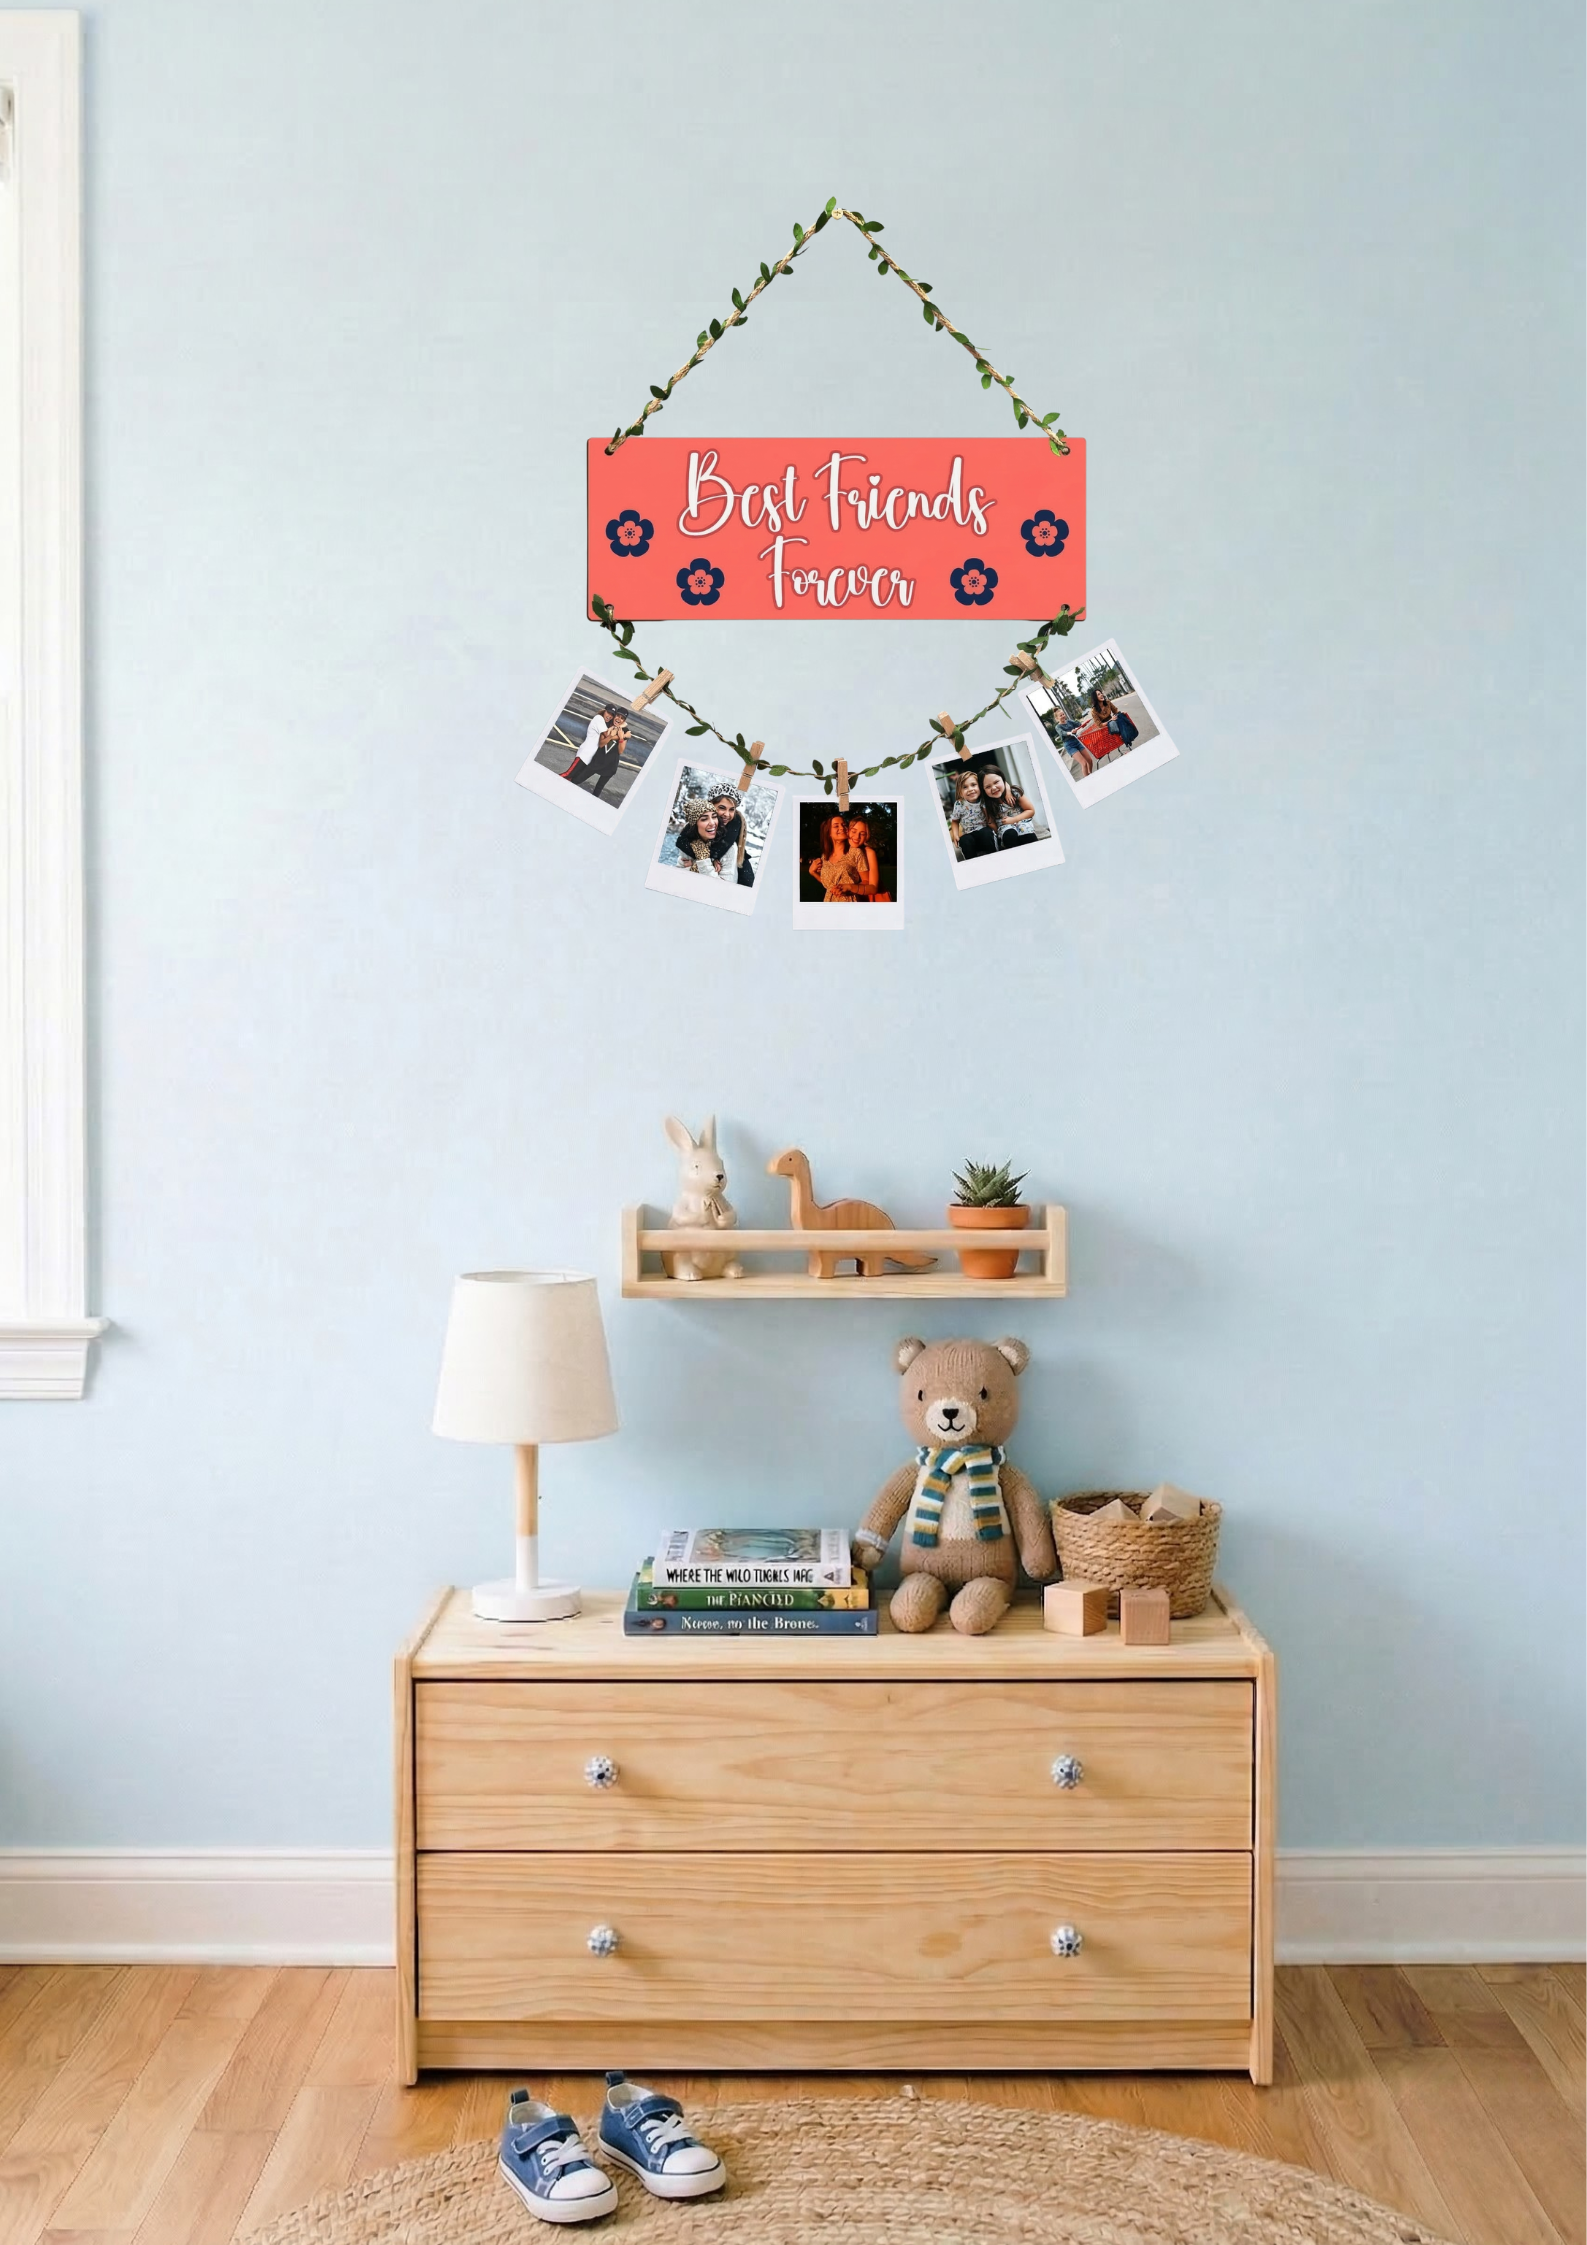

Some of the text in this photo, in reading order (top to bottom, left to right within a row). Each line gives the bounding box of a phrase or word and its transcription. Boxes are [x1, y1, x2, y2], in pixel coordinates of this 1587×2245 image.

[677, 450, 997, 537] Best Friends
[758, 535, 916, 608] Forever
[667, 1568, 701, 1583] WHERE
[703, 1568, 723, 1583] THE
